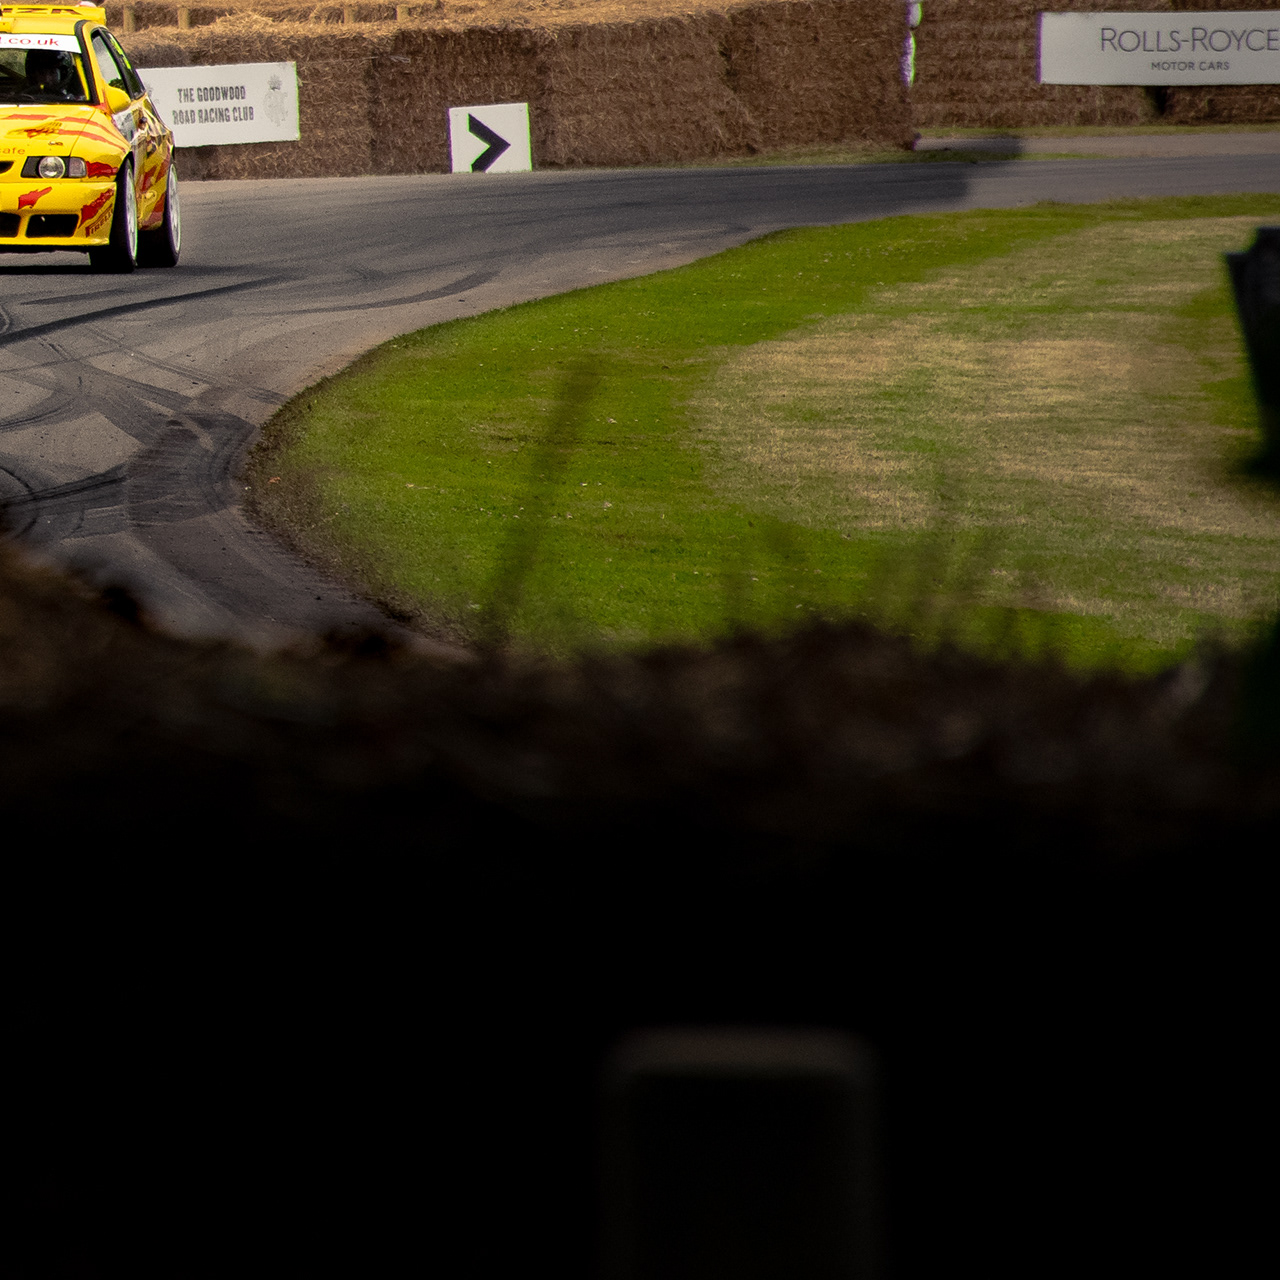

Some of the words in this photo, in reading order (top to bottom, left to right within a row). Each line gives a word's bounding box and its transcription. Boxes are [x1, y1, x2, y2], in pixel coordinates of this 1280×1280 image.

[1101, 27, 1280, 52] ROLLS-ROYCE
[1151, 61, 1195, 71] MOTOR
[1198, 61, 1230, 71] CARS
[177, 87, 195, 103] THE
[196, 85, 246, 102] GOODWOOD
[172, 109, 196, 125] ROAD
[198, 107, 231, 124] RACING
[232, 106, 255, 122] CLUB
